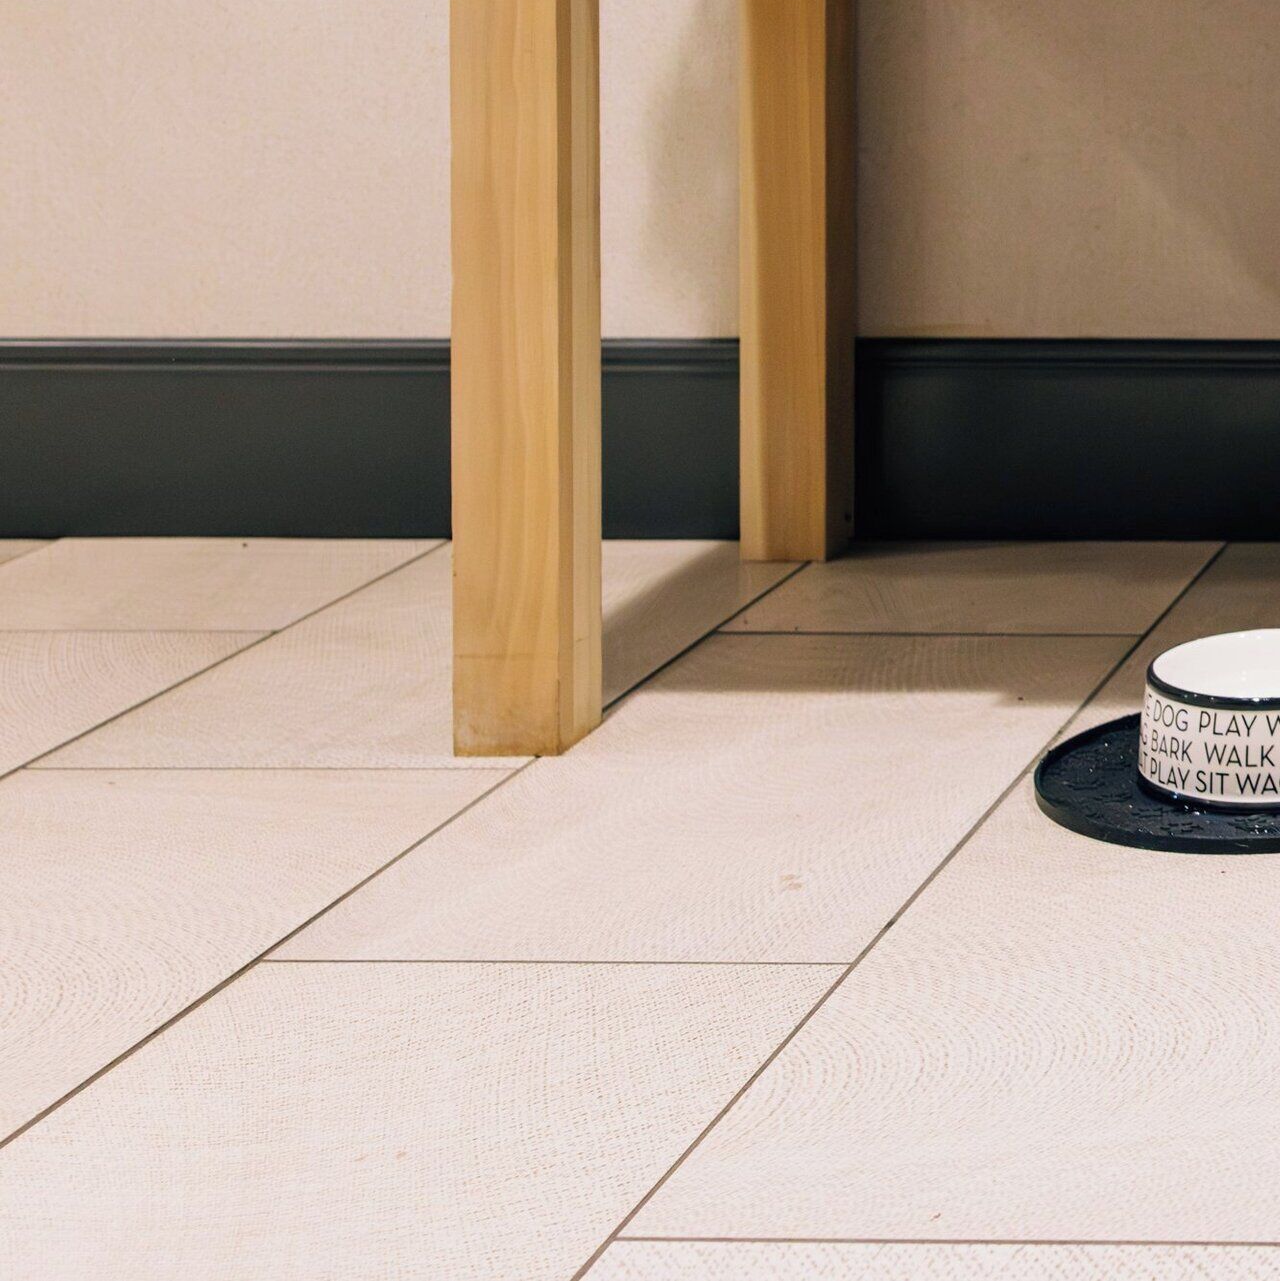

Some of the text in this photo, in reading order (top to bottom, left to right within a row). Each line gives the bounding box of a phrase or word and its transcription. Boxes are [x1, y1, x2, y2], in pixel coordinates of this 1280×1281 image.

[1153, 699, 1189, 733] DOG
[1198, 710, 1257, 738] PLAY
[1151, 729, 1193, 764] BARK
[1204, 742, 1275, 769] WALK
[1150, 756, 1190, 791] PLAY
[1195, 770, 1229, 796] SIT
